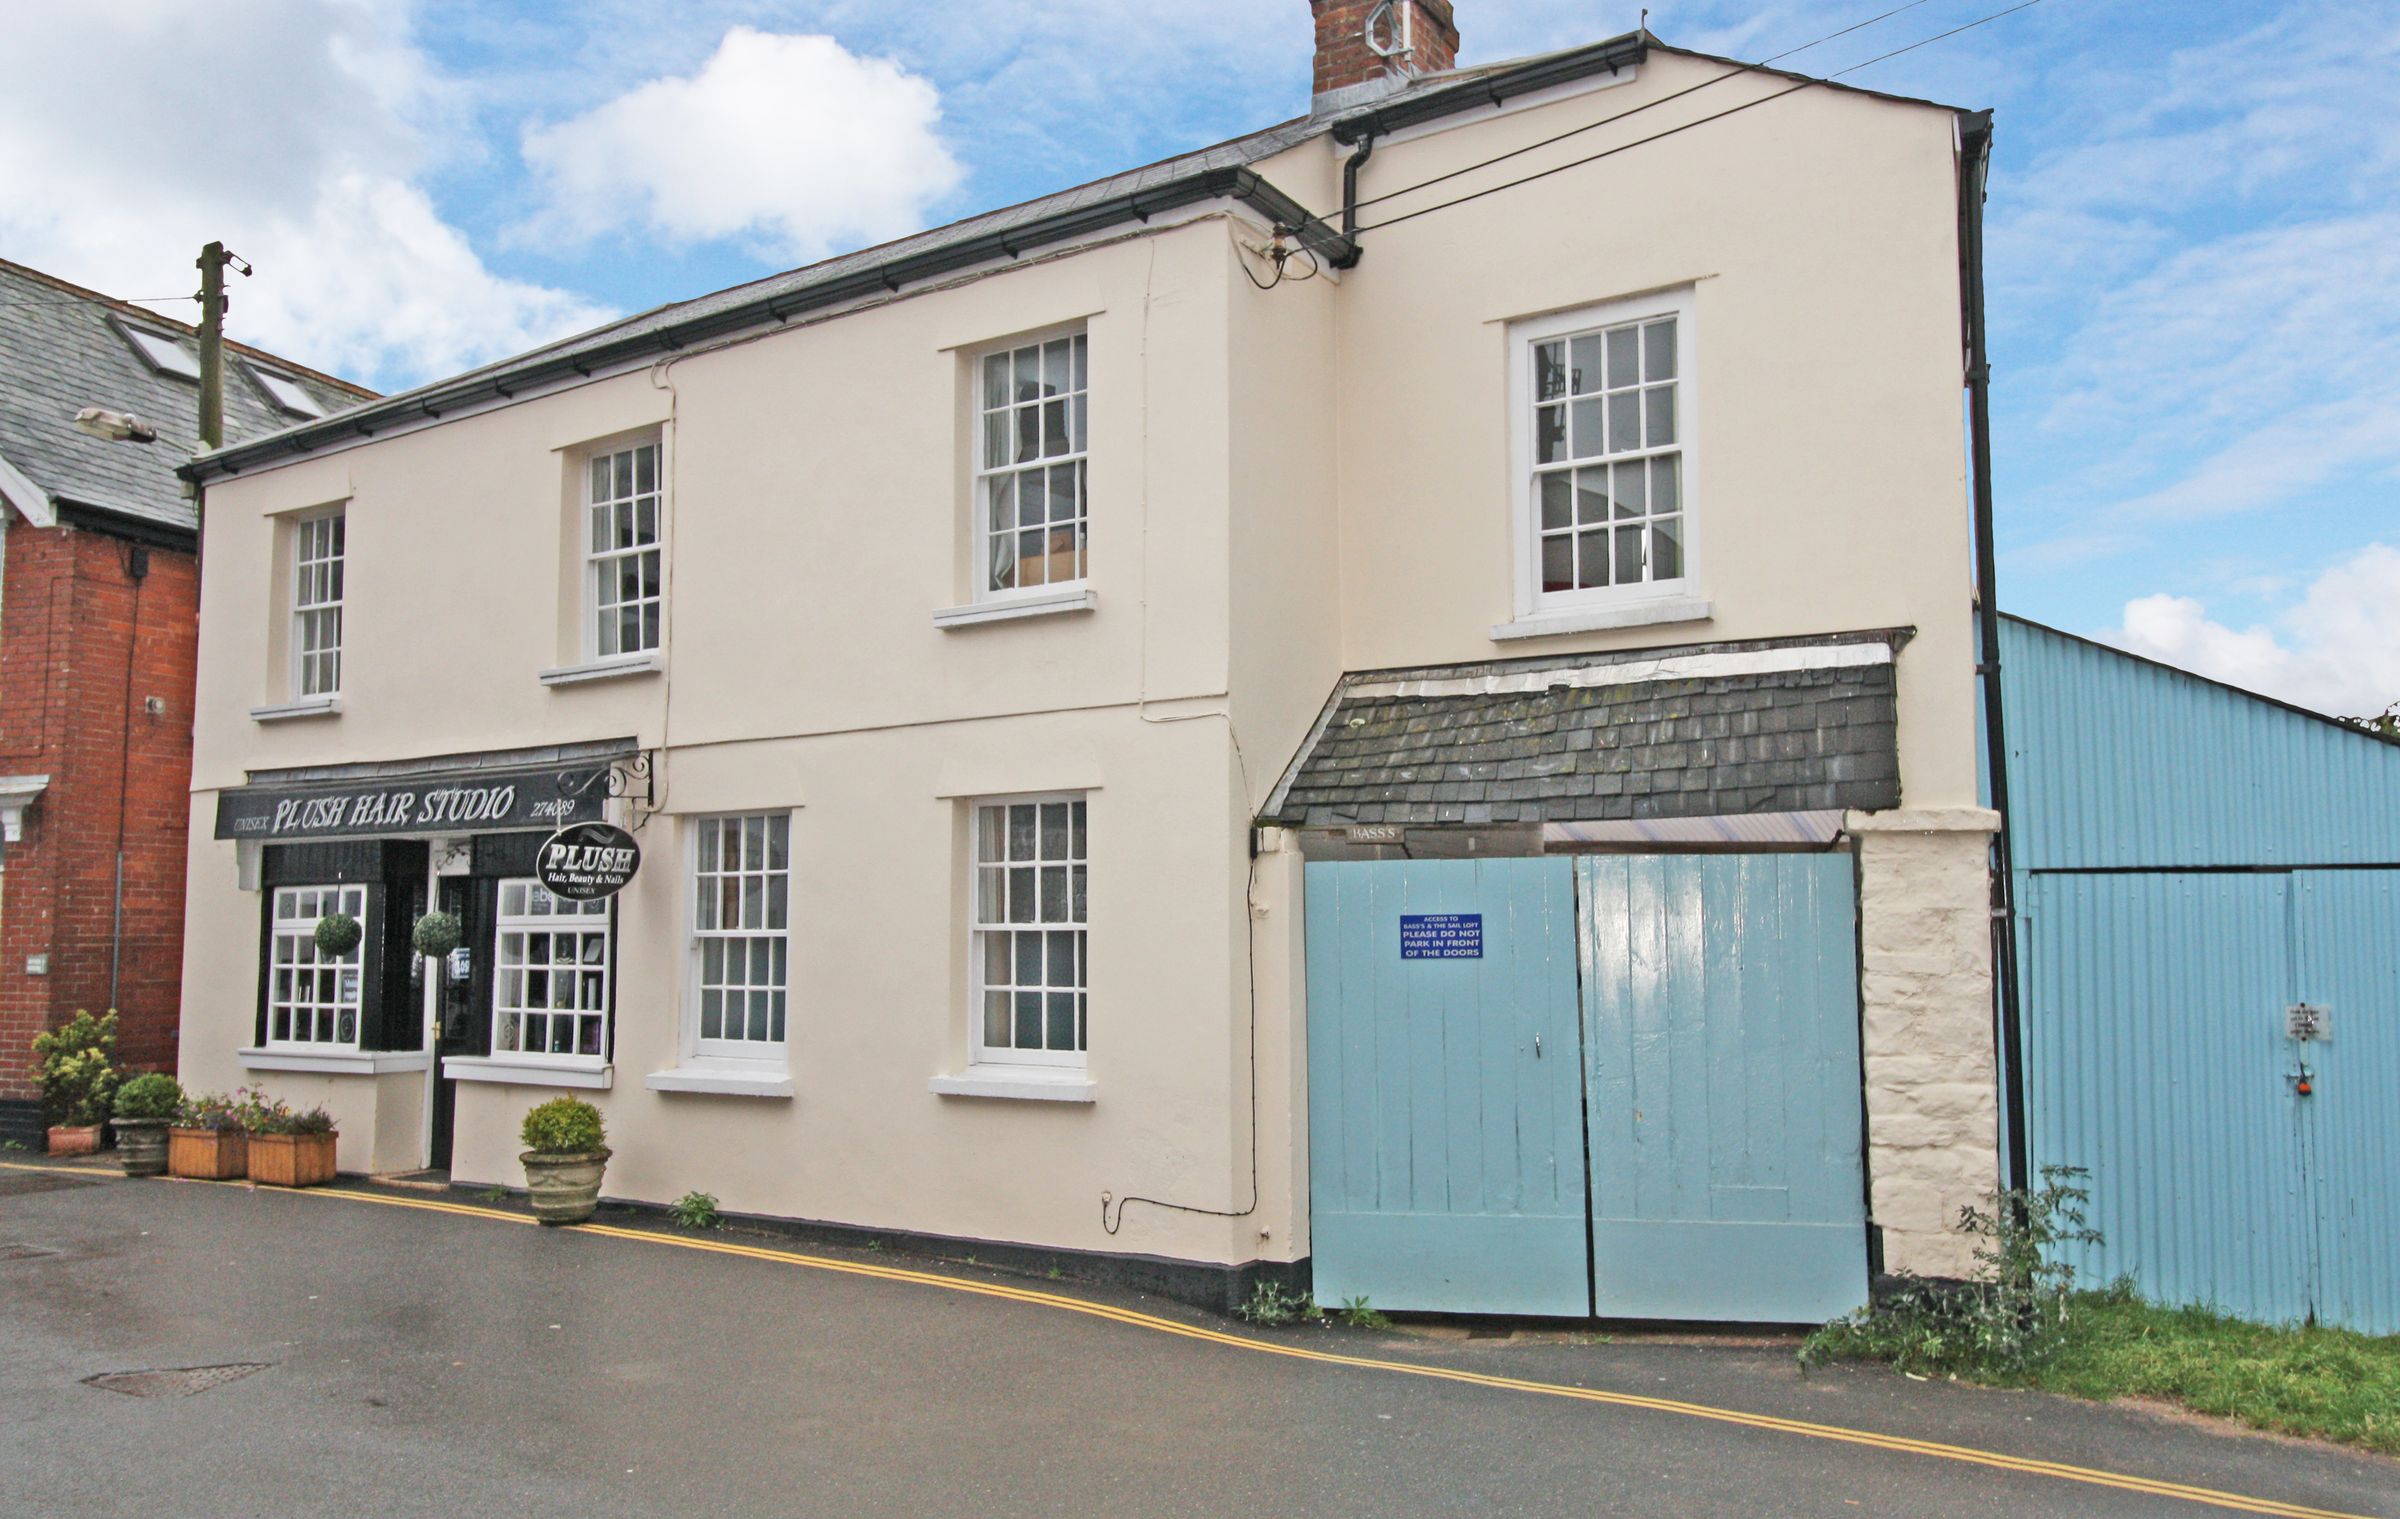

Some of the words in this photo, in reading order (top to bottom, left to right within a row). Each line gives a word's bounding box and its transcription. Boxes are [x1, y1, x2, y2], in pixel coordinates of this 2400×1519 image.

[234, 816, 271, 832] UNISEX
[272, 796, 351, 834] PLUSH
[349, 792, 416, 826] HAIR
[416, 784, 516, 824] STUDIO
[545, 844, 636, 872] PLUSH
[548, 872, 567, 884] Hair,
[568, 873, 595, 885] Beauty
[596, 874, 603, 884] &
[604, 874, 624, 884] Nails
[567, 886, 596, 894] UNISEX
[1447, 939, 1480, 947] FRONT
